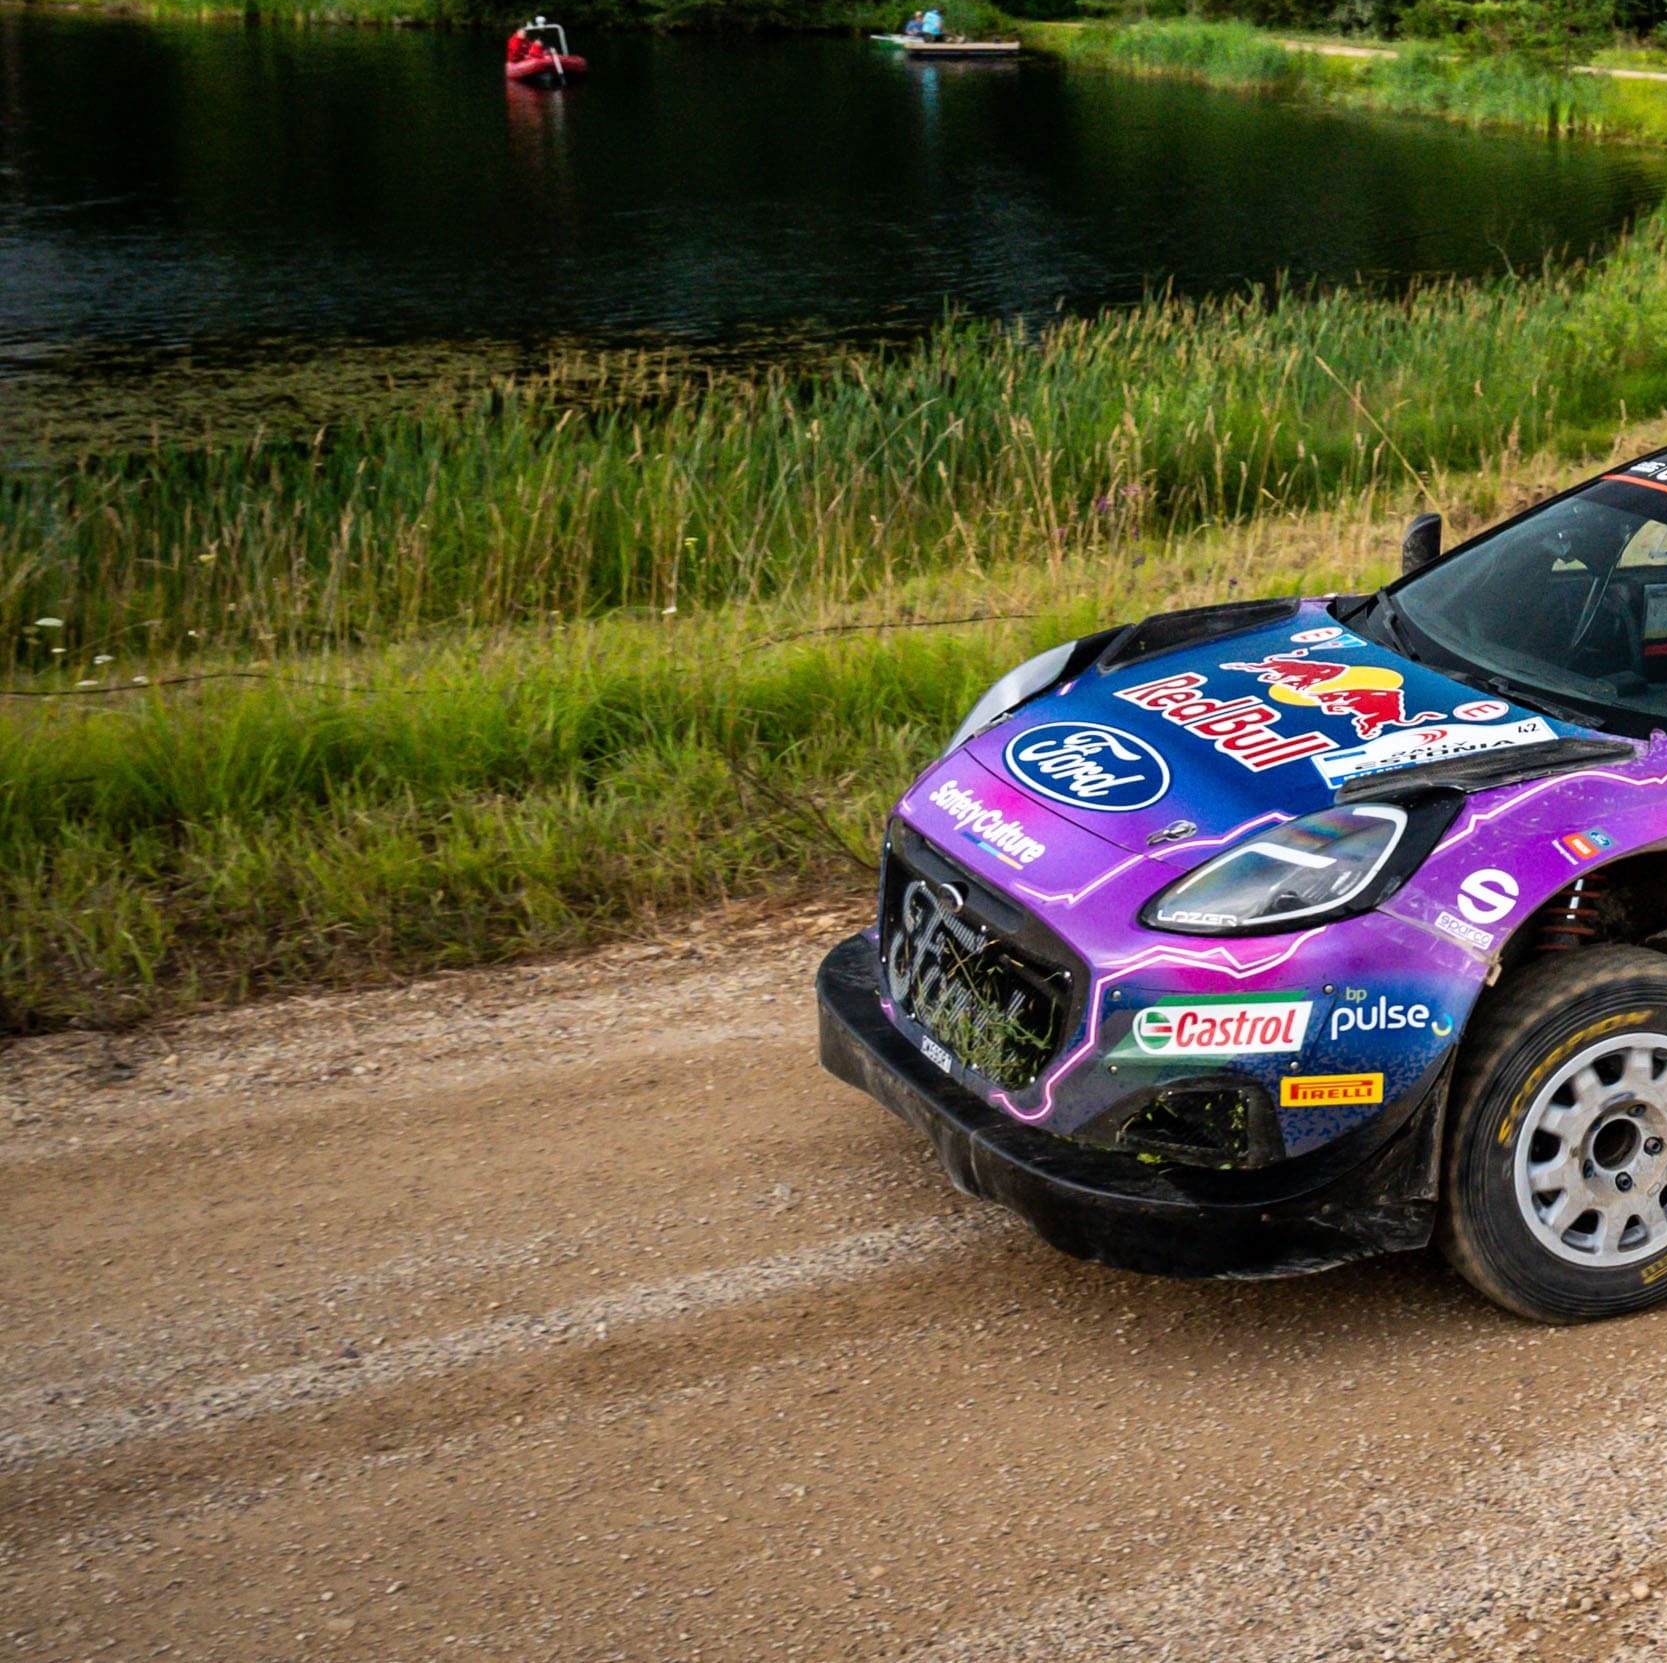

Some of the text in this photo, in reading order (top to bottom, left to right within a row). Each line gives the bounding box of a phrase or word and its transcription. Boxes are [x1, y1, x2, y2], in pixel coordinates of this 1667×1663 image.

[1518, 723, 1541, 734] 42
[1018, 730, 1146, 798] Ford
[929, 780, 1046, 864] SafetyCulture
[1157, 910, 1239, 926] LAZER
[1437, 913, 1492, 947] sparco
[1345, 986, 1368, 1003] bp
[1175, 1008, 1297, 1048] Castrol
[1331, 996, 1430, 1040] pulse
[1290, 1079, 1374, 1101] PIRELLI
[1498, 1009, 1657, 1148] SCORPION
